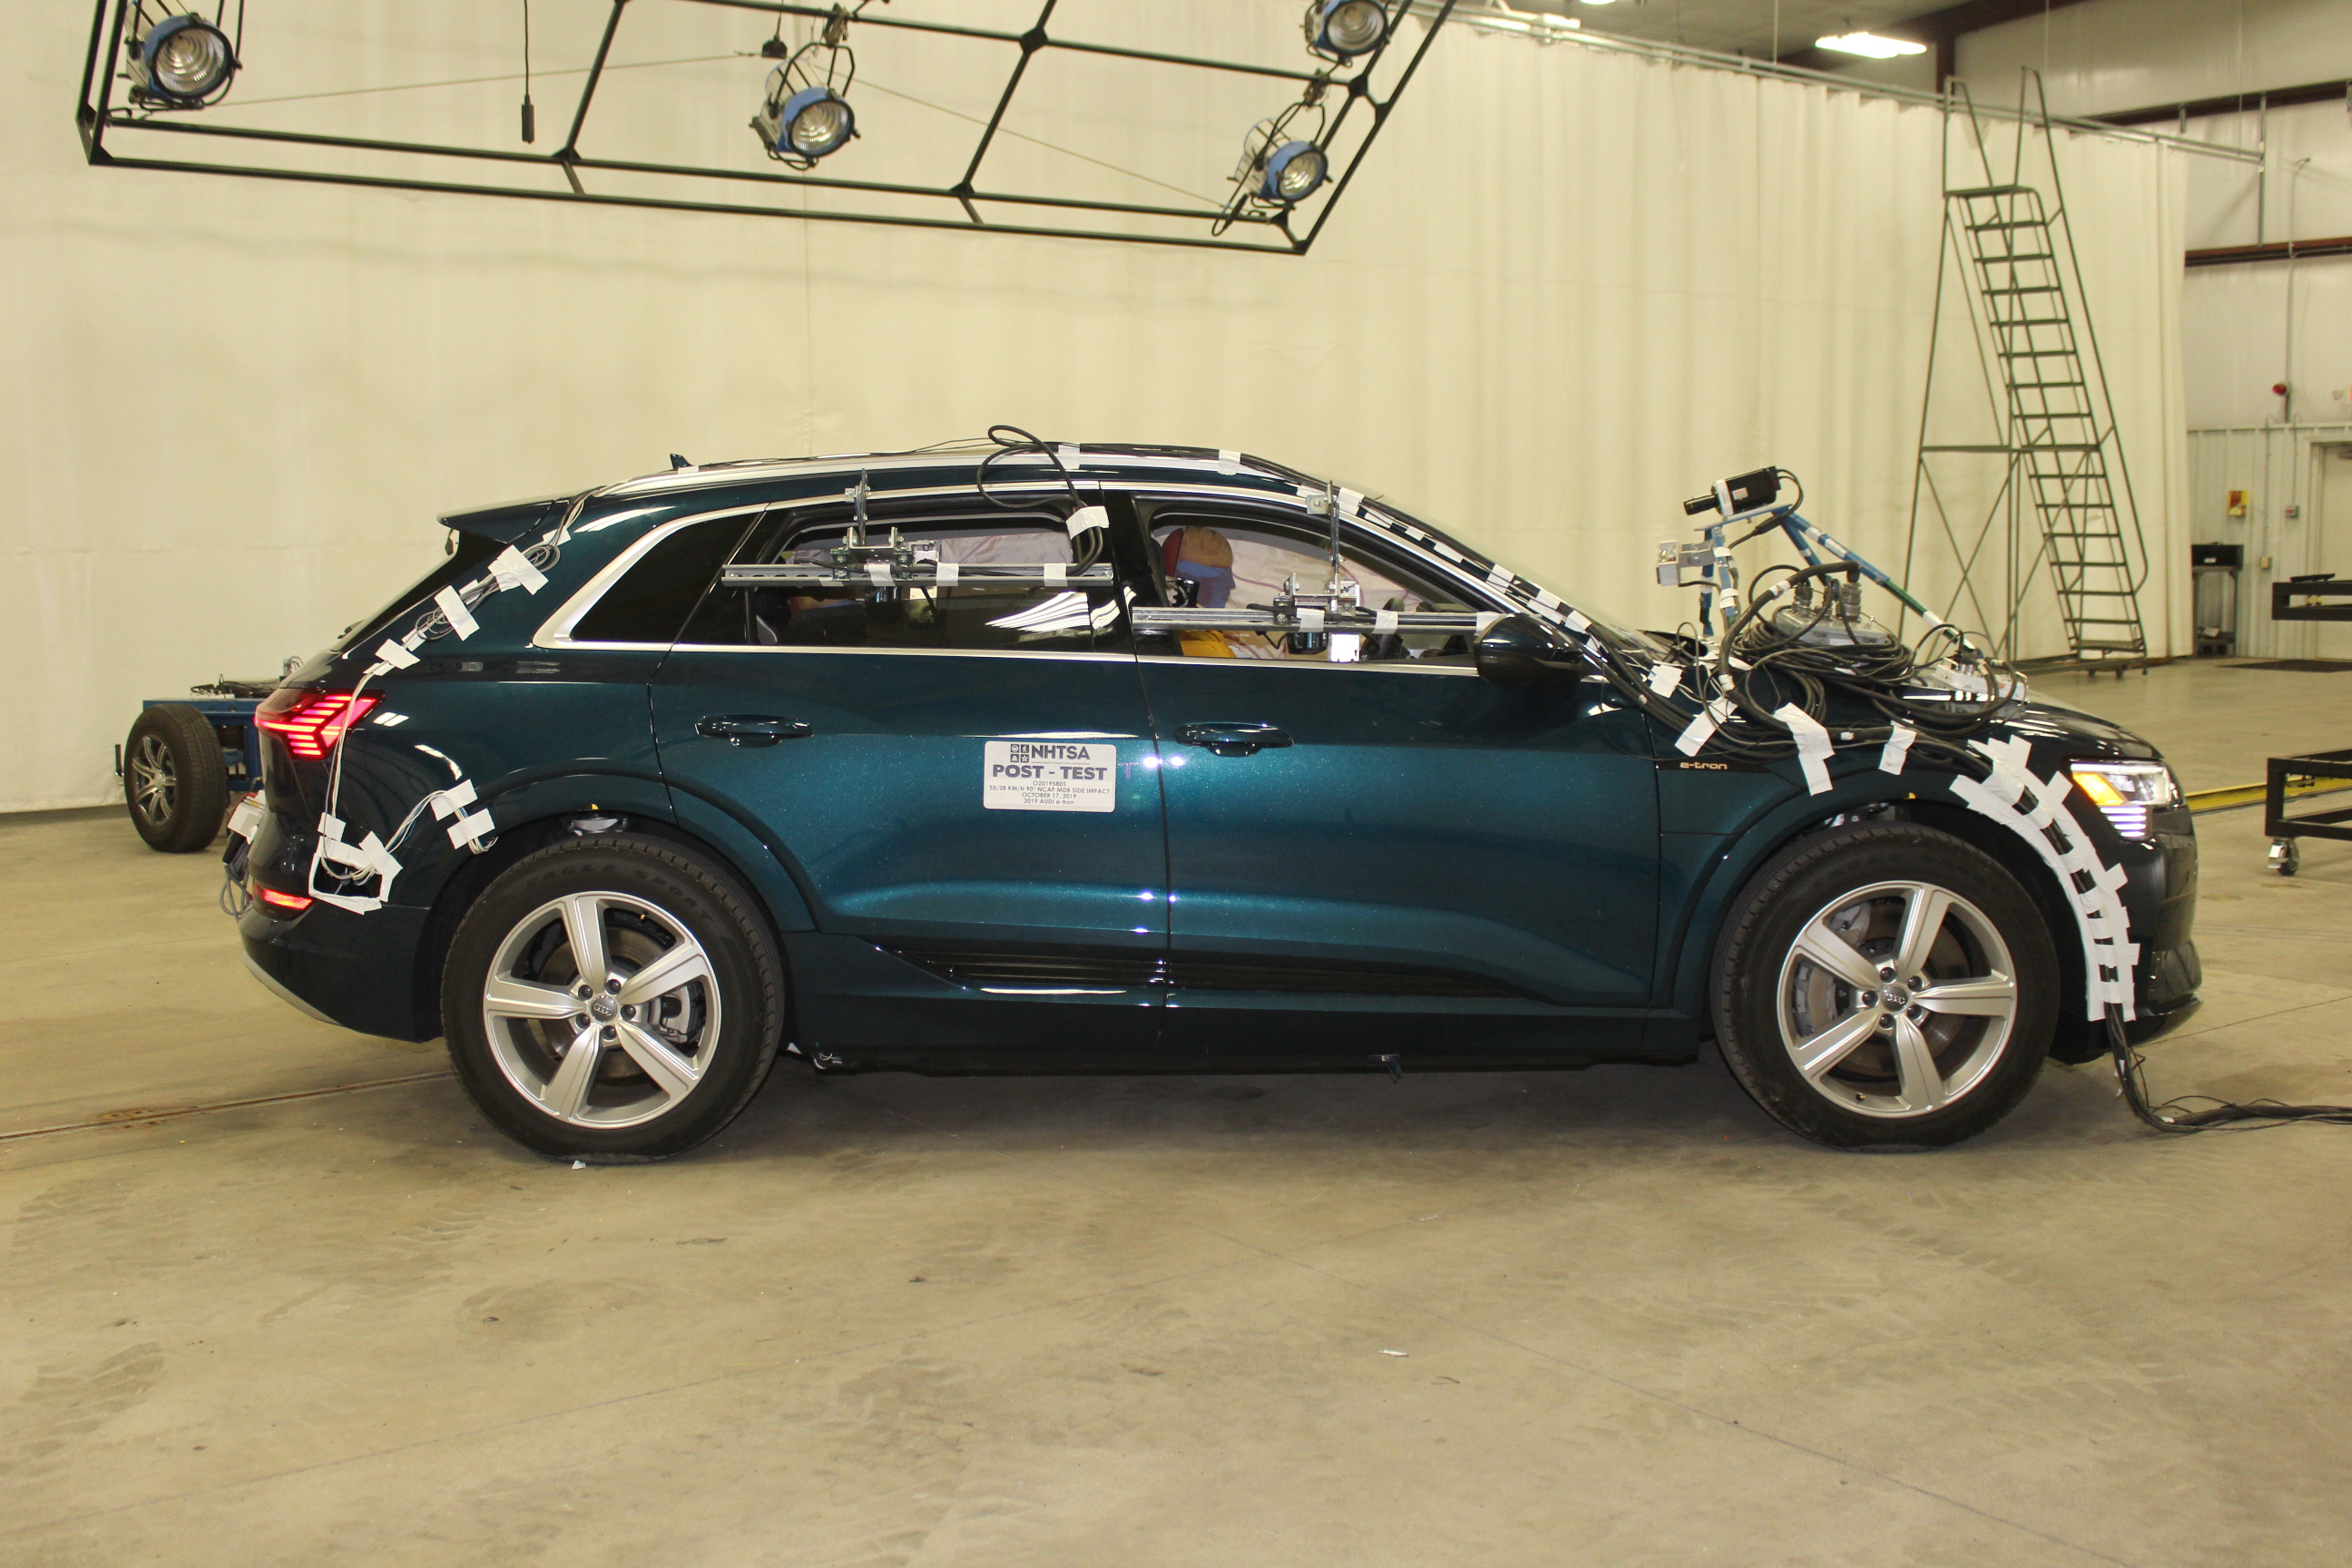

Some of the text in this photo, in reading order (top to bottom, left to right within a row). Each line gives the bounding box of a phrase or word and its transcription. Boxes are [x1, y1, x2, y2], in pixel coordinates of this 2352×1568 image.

[1032, 744, 1091, 760] NHTSA
[992, 764, 1044, 779] POST
[1059, 766, 1108, 780] TEST
[1680, 761, 1728, 770] e-tron
